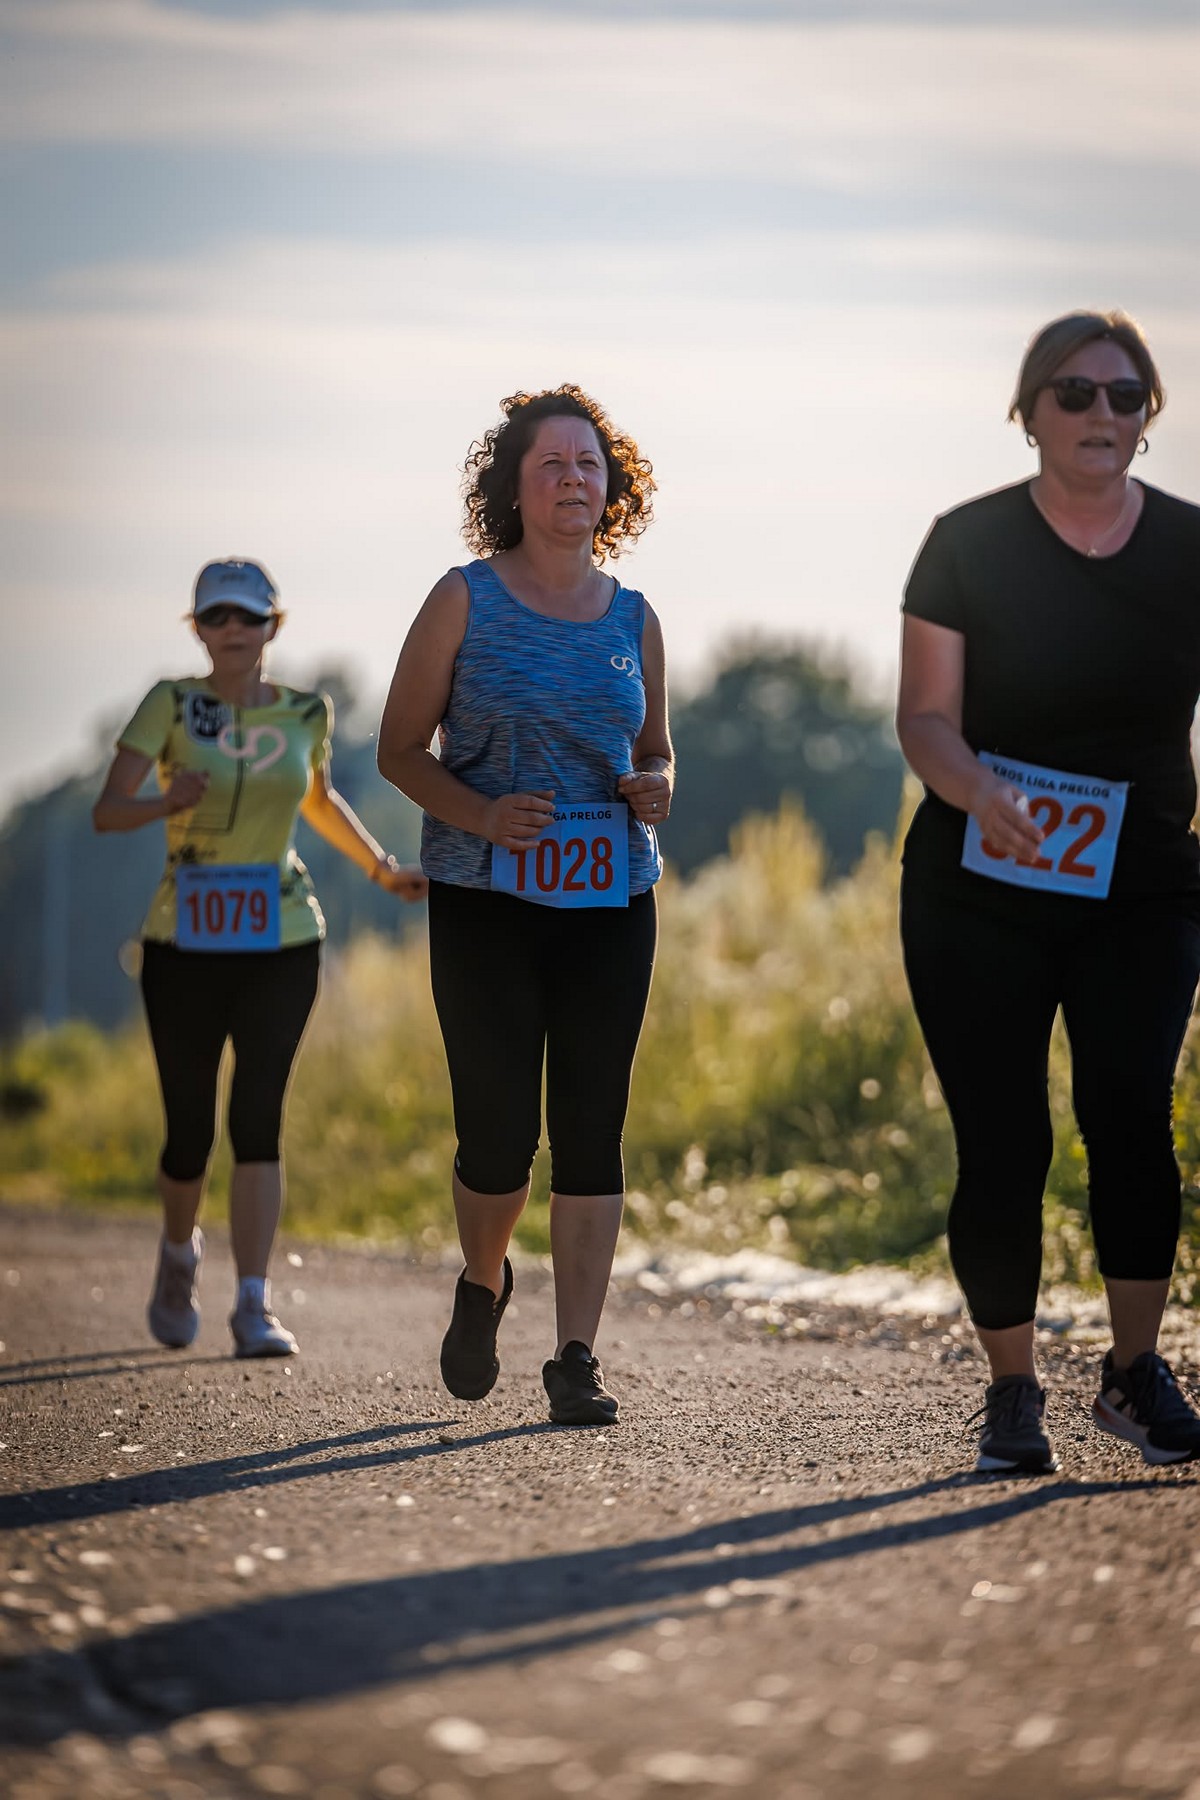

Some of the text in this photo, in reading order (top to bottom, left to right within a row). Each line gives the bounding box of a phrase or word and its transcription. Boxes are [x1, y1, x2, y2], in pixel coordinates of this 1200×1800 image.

[1026, 775, 1055, 791] LIGA
[1059, 781, 1110, 799] PRELOG
[570, 810, 612, 821] PRELOG
[980, 796, 1106, 879] 22
[509, 836, 614, 892] 1028
[186, 889, 268, 934] 1079
